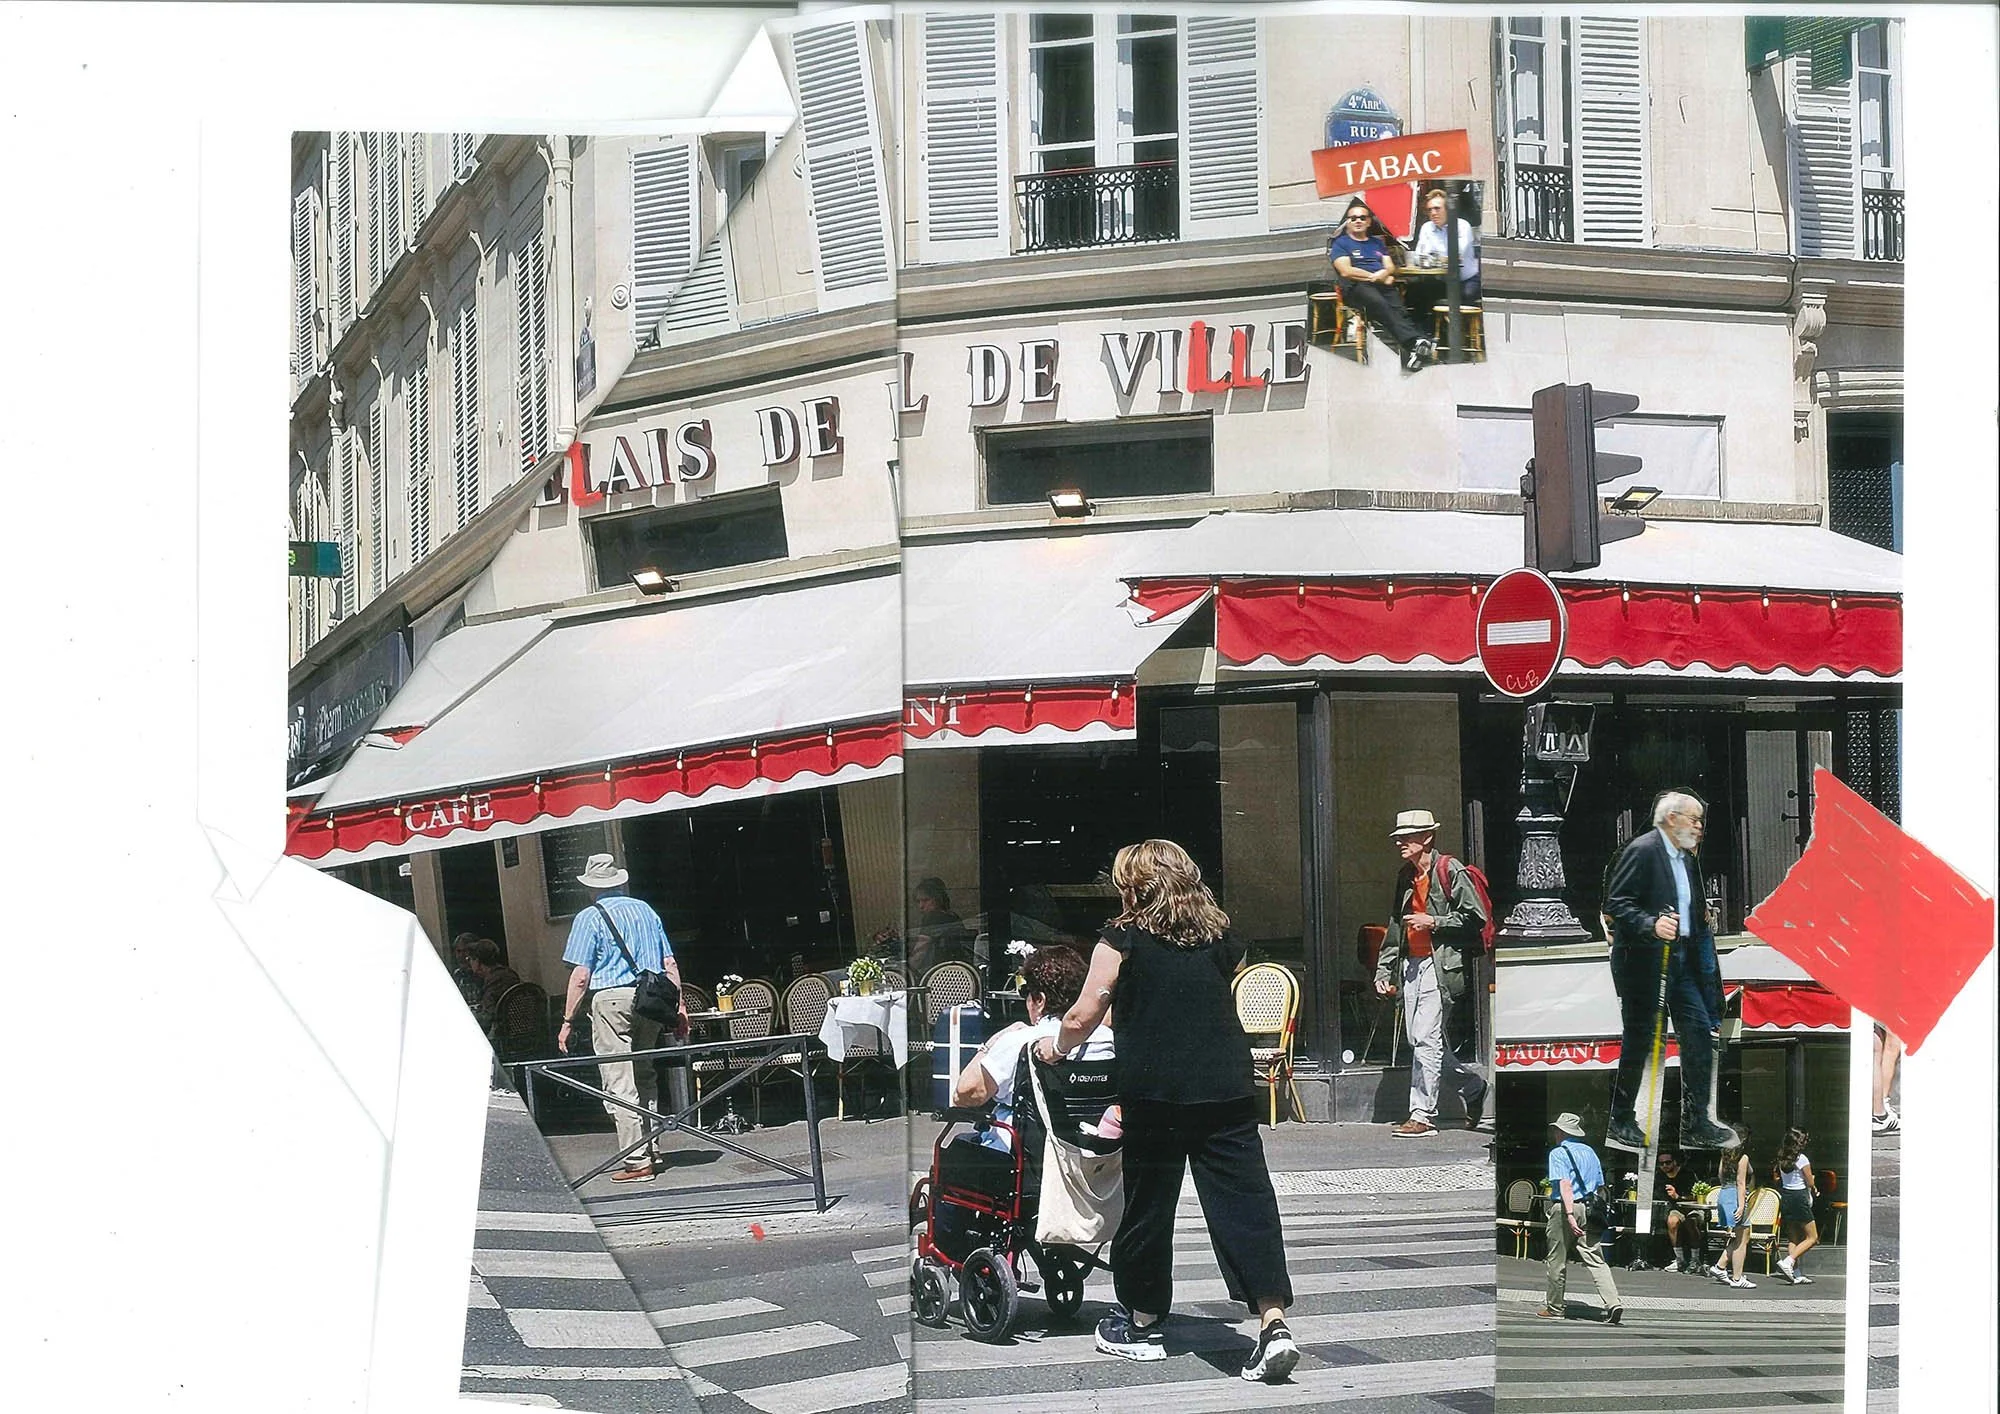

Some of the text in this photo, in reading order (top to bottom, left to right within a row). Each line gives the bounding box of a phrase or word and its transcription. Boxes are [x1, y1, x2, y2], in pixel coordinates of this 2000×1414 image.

[1350, 126, 1378, 139] RUE
[1338, 150, 1443, 187] TABAC
[966, 339, 1061, 408] DE
[1100, 319, 1312, 396] VILLE
[754, 395, 845, 468] DE
